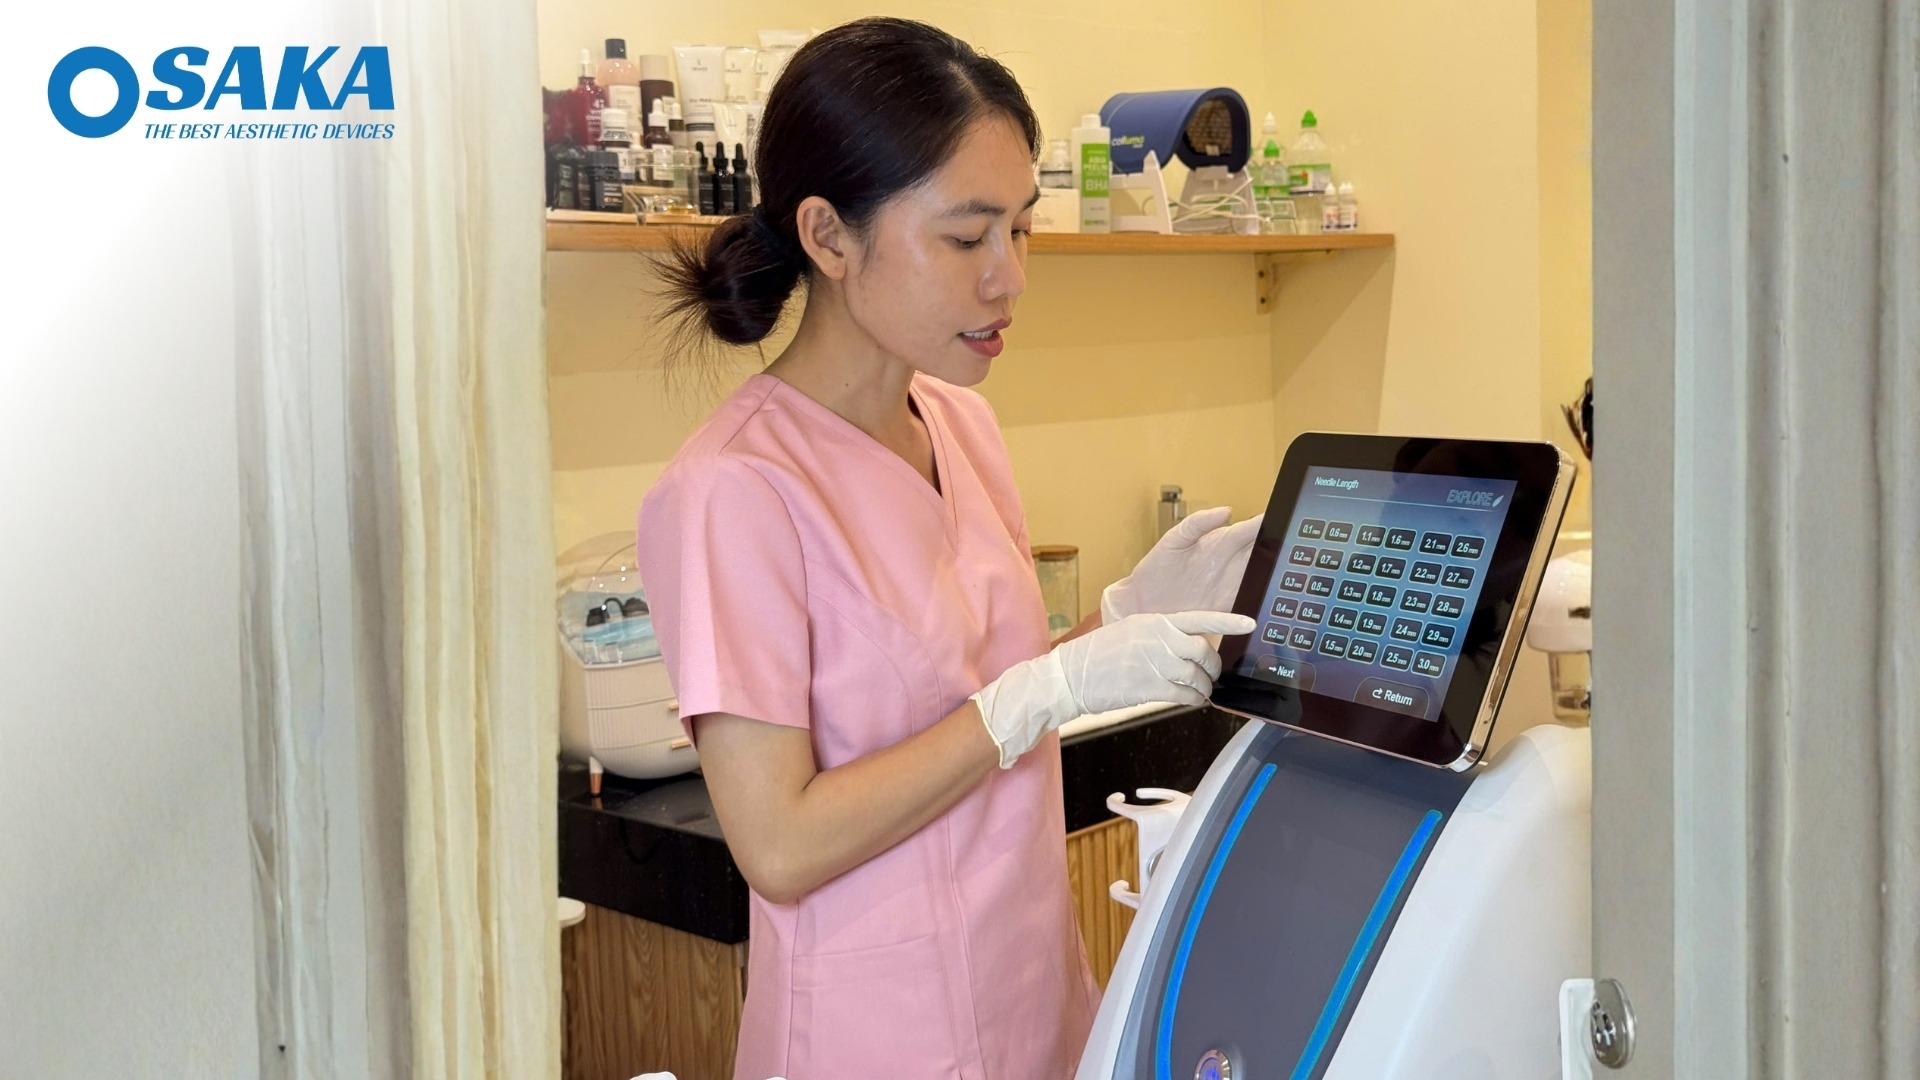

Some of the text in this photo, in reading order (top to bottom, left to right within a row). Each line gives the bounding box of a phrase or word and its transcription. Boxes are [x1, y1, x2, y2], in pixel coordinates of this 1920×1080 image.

[1315, 476, 1359, 490] Needle Length
[1446, 489, 1494, 507] EXPLORE
[1277, 665, 1296, 679] Next
[1383, 689, 1413, 706] Return
